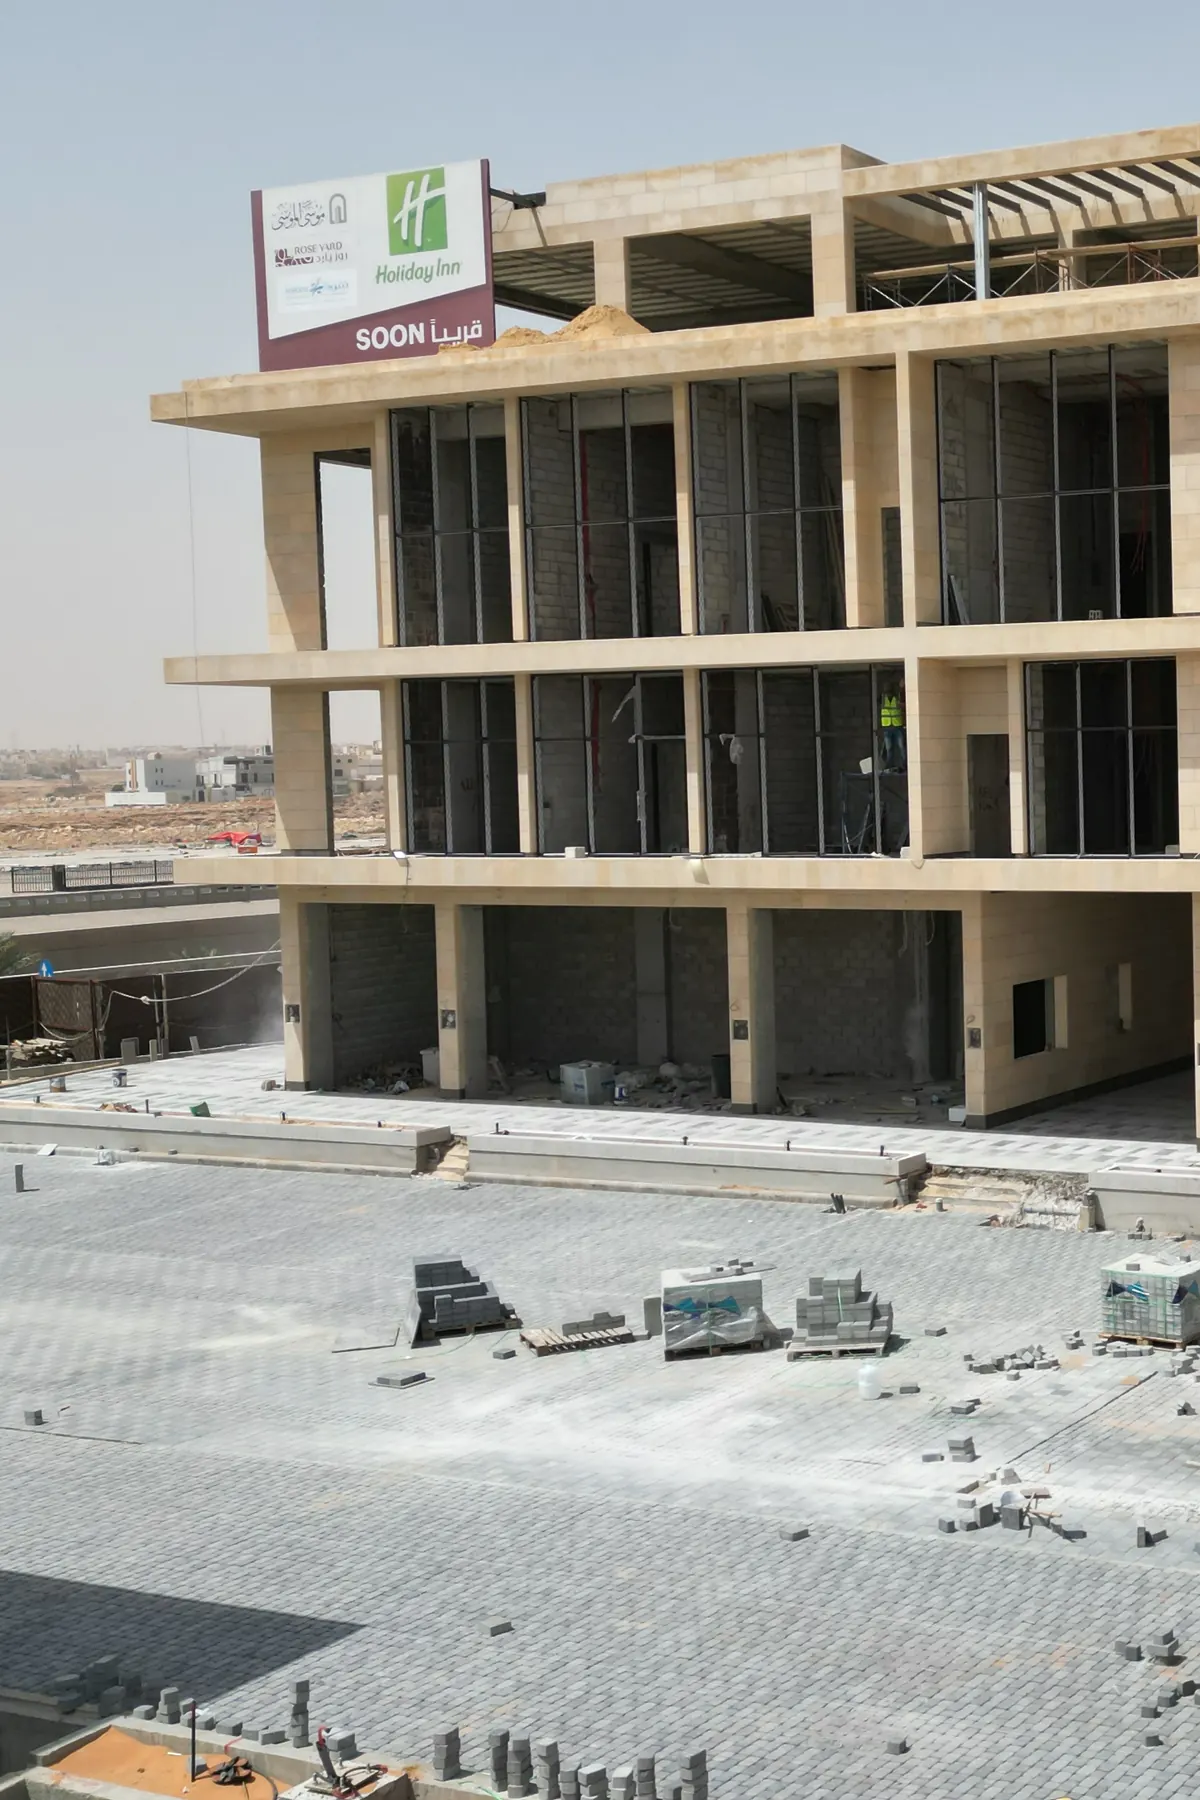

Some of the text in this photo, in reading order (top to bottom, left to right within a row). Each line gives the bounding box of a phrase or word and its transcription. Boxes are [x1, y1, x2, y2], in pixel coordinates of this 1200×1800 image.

[294, 241, 343, 255] ROSE YARD
[375, 257, 461, 284] Holiday Inn
[356, 322, 425, 351] SOON
